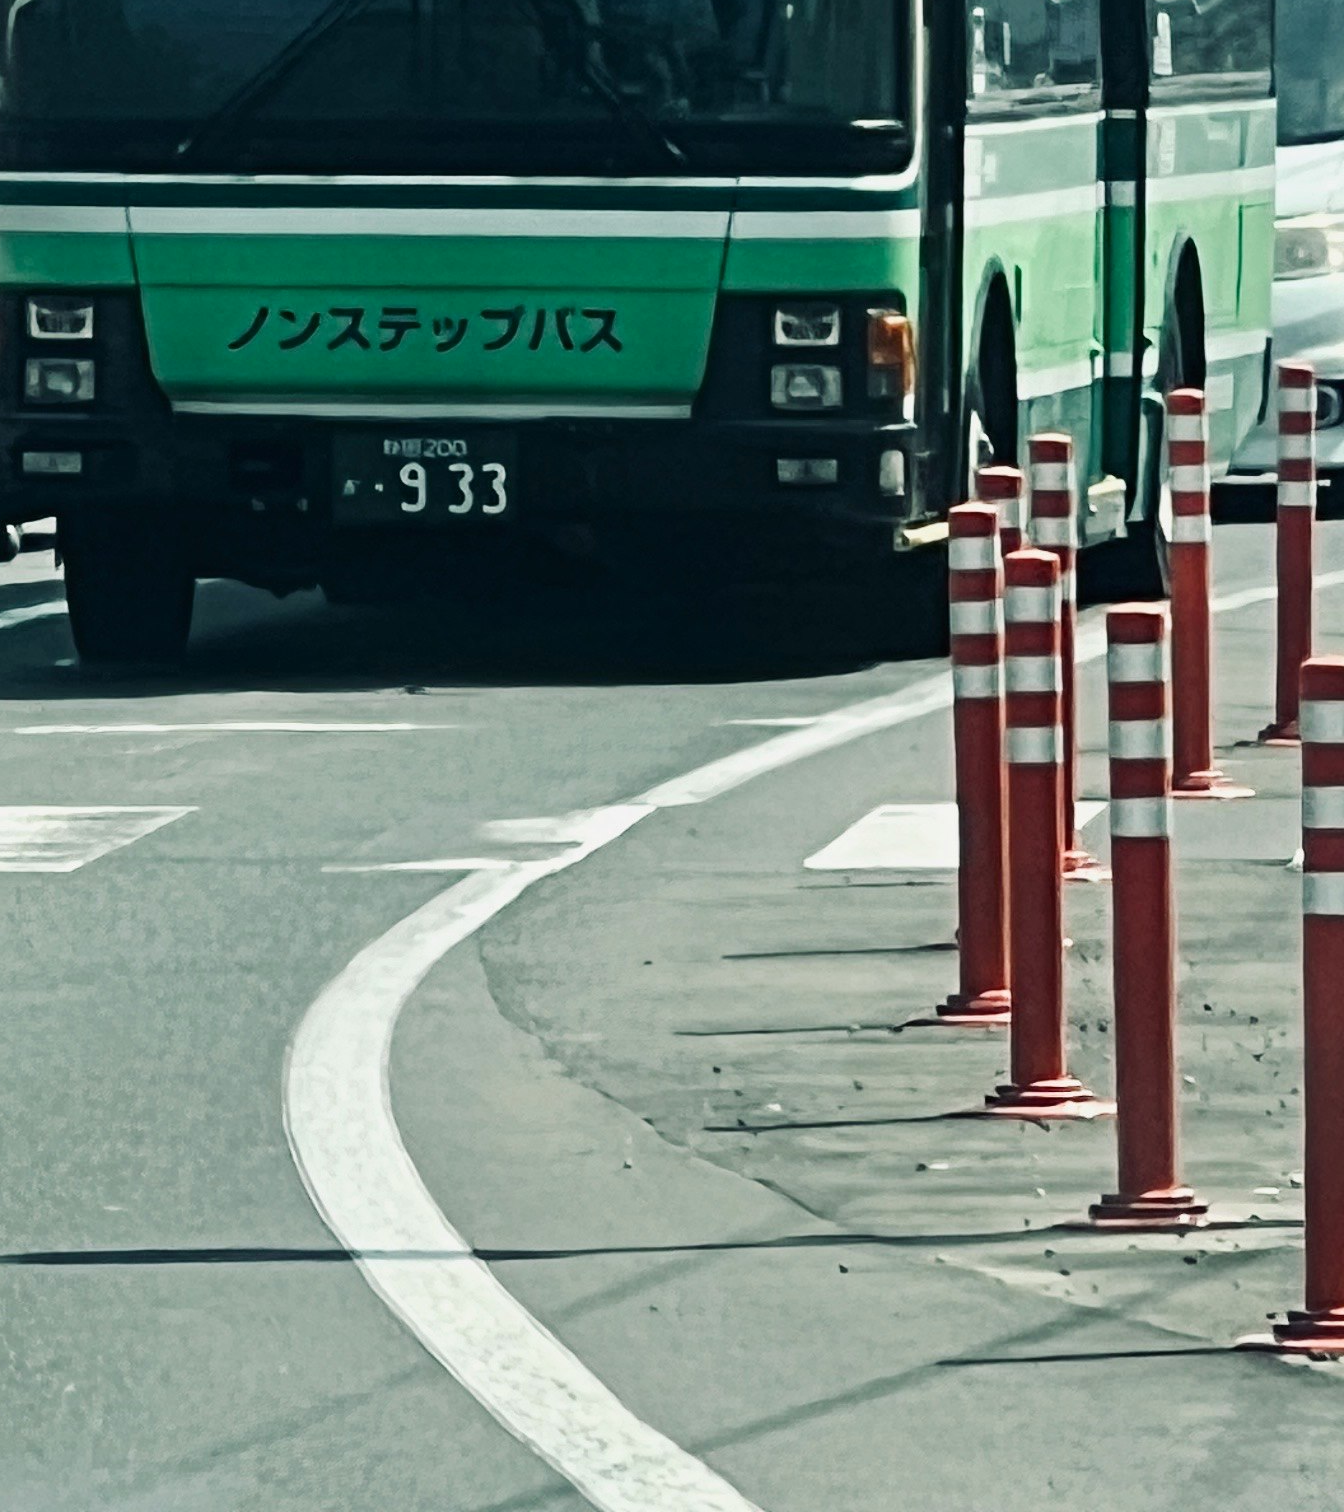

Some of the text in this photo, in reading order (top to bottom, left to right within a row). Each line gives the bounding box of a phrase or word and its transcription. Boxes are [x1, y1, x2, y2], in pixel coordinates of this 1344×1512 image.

[227, 304, 623, 352] ノンステップバス
